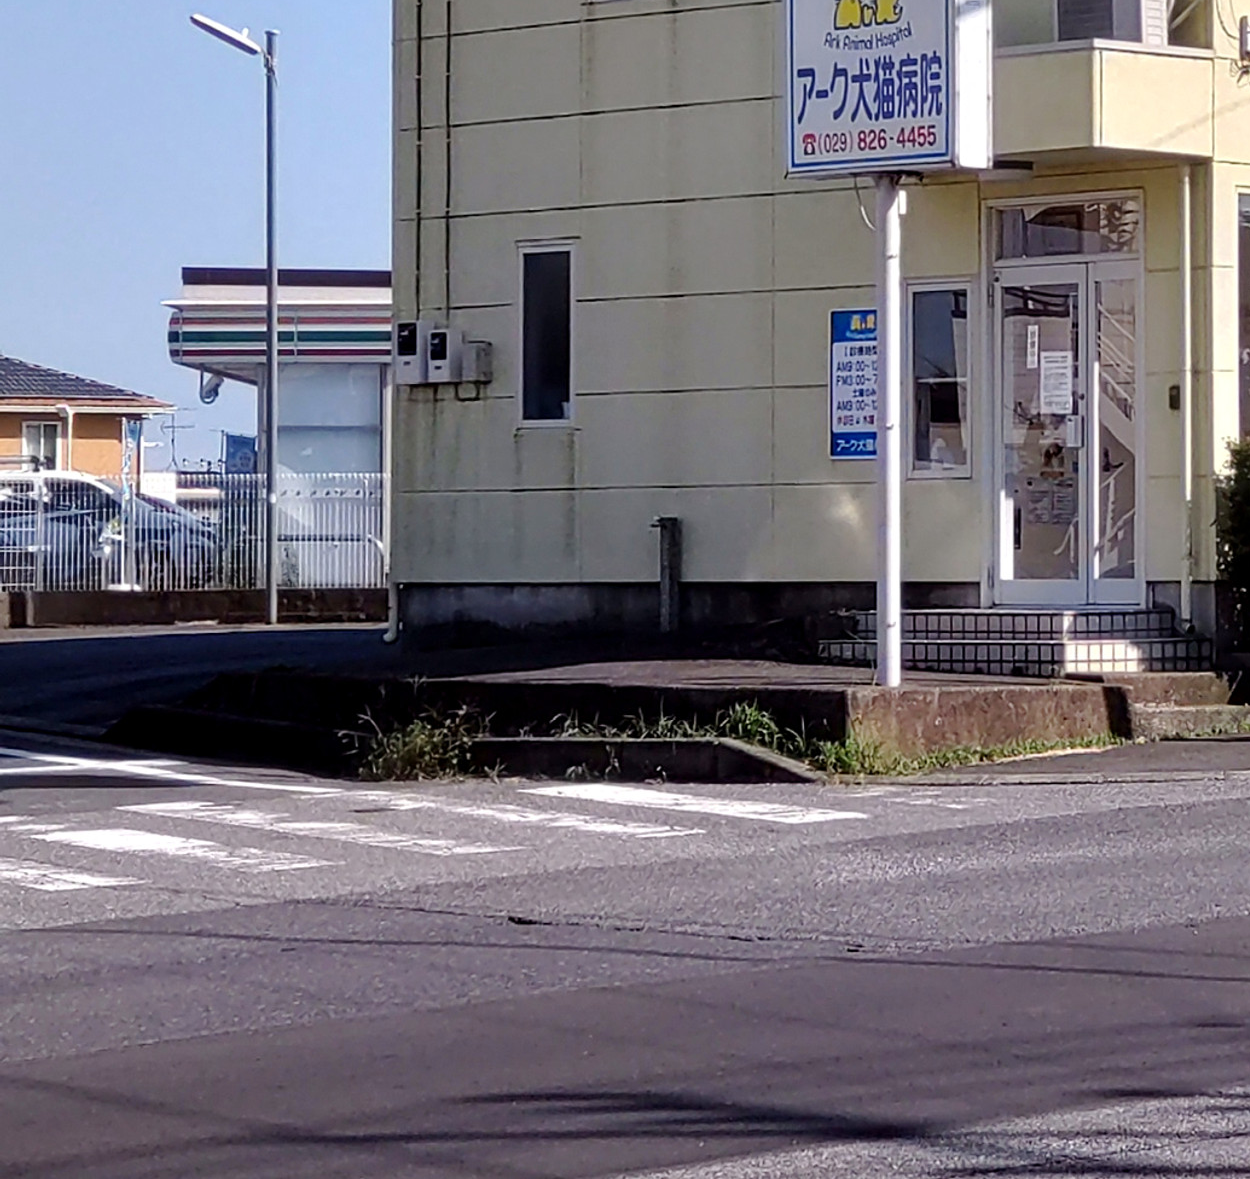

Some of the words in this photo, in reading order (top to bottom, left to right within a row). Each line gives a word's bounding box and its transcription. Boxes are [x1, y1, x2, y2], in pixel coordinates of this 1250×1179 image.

[824, 32, 841, 49] Ark
[843, 34, 874, 50] Animal
[876, 22, 912, 48] Hospital
[797, 50, 943, 124] アーク犬猫病院
[818, 132, 854, 155] (029)
[857, 124, 937, 152] 826-4455
